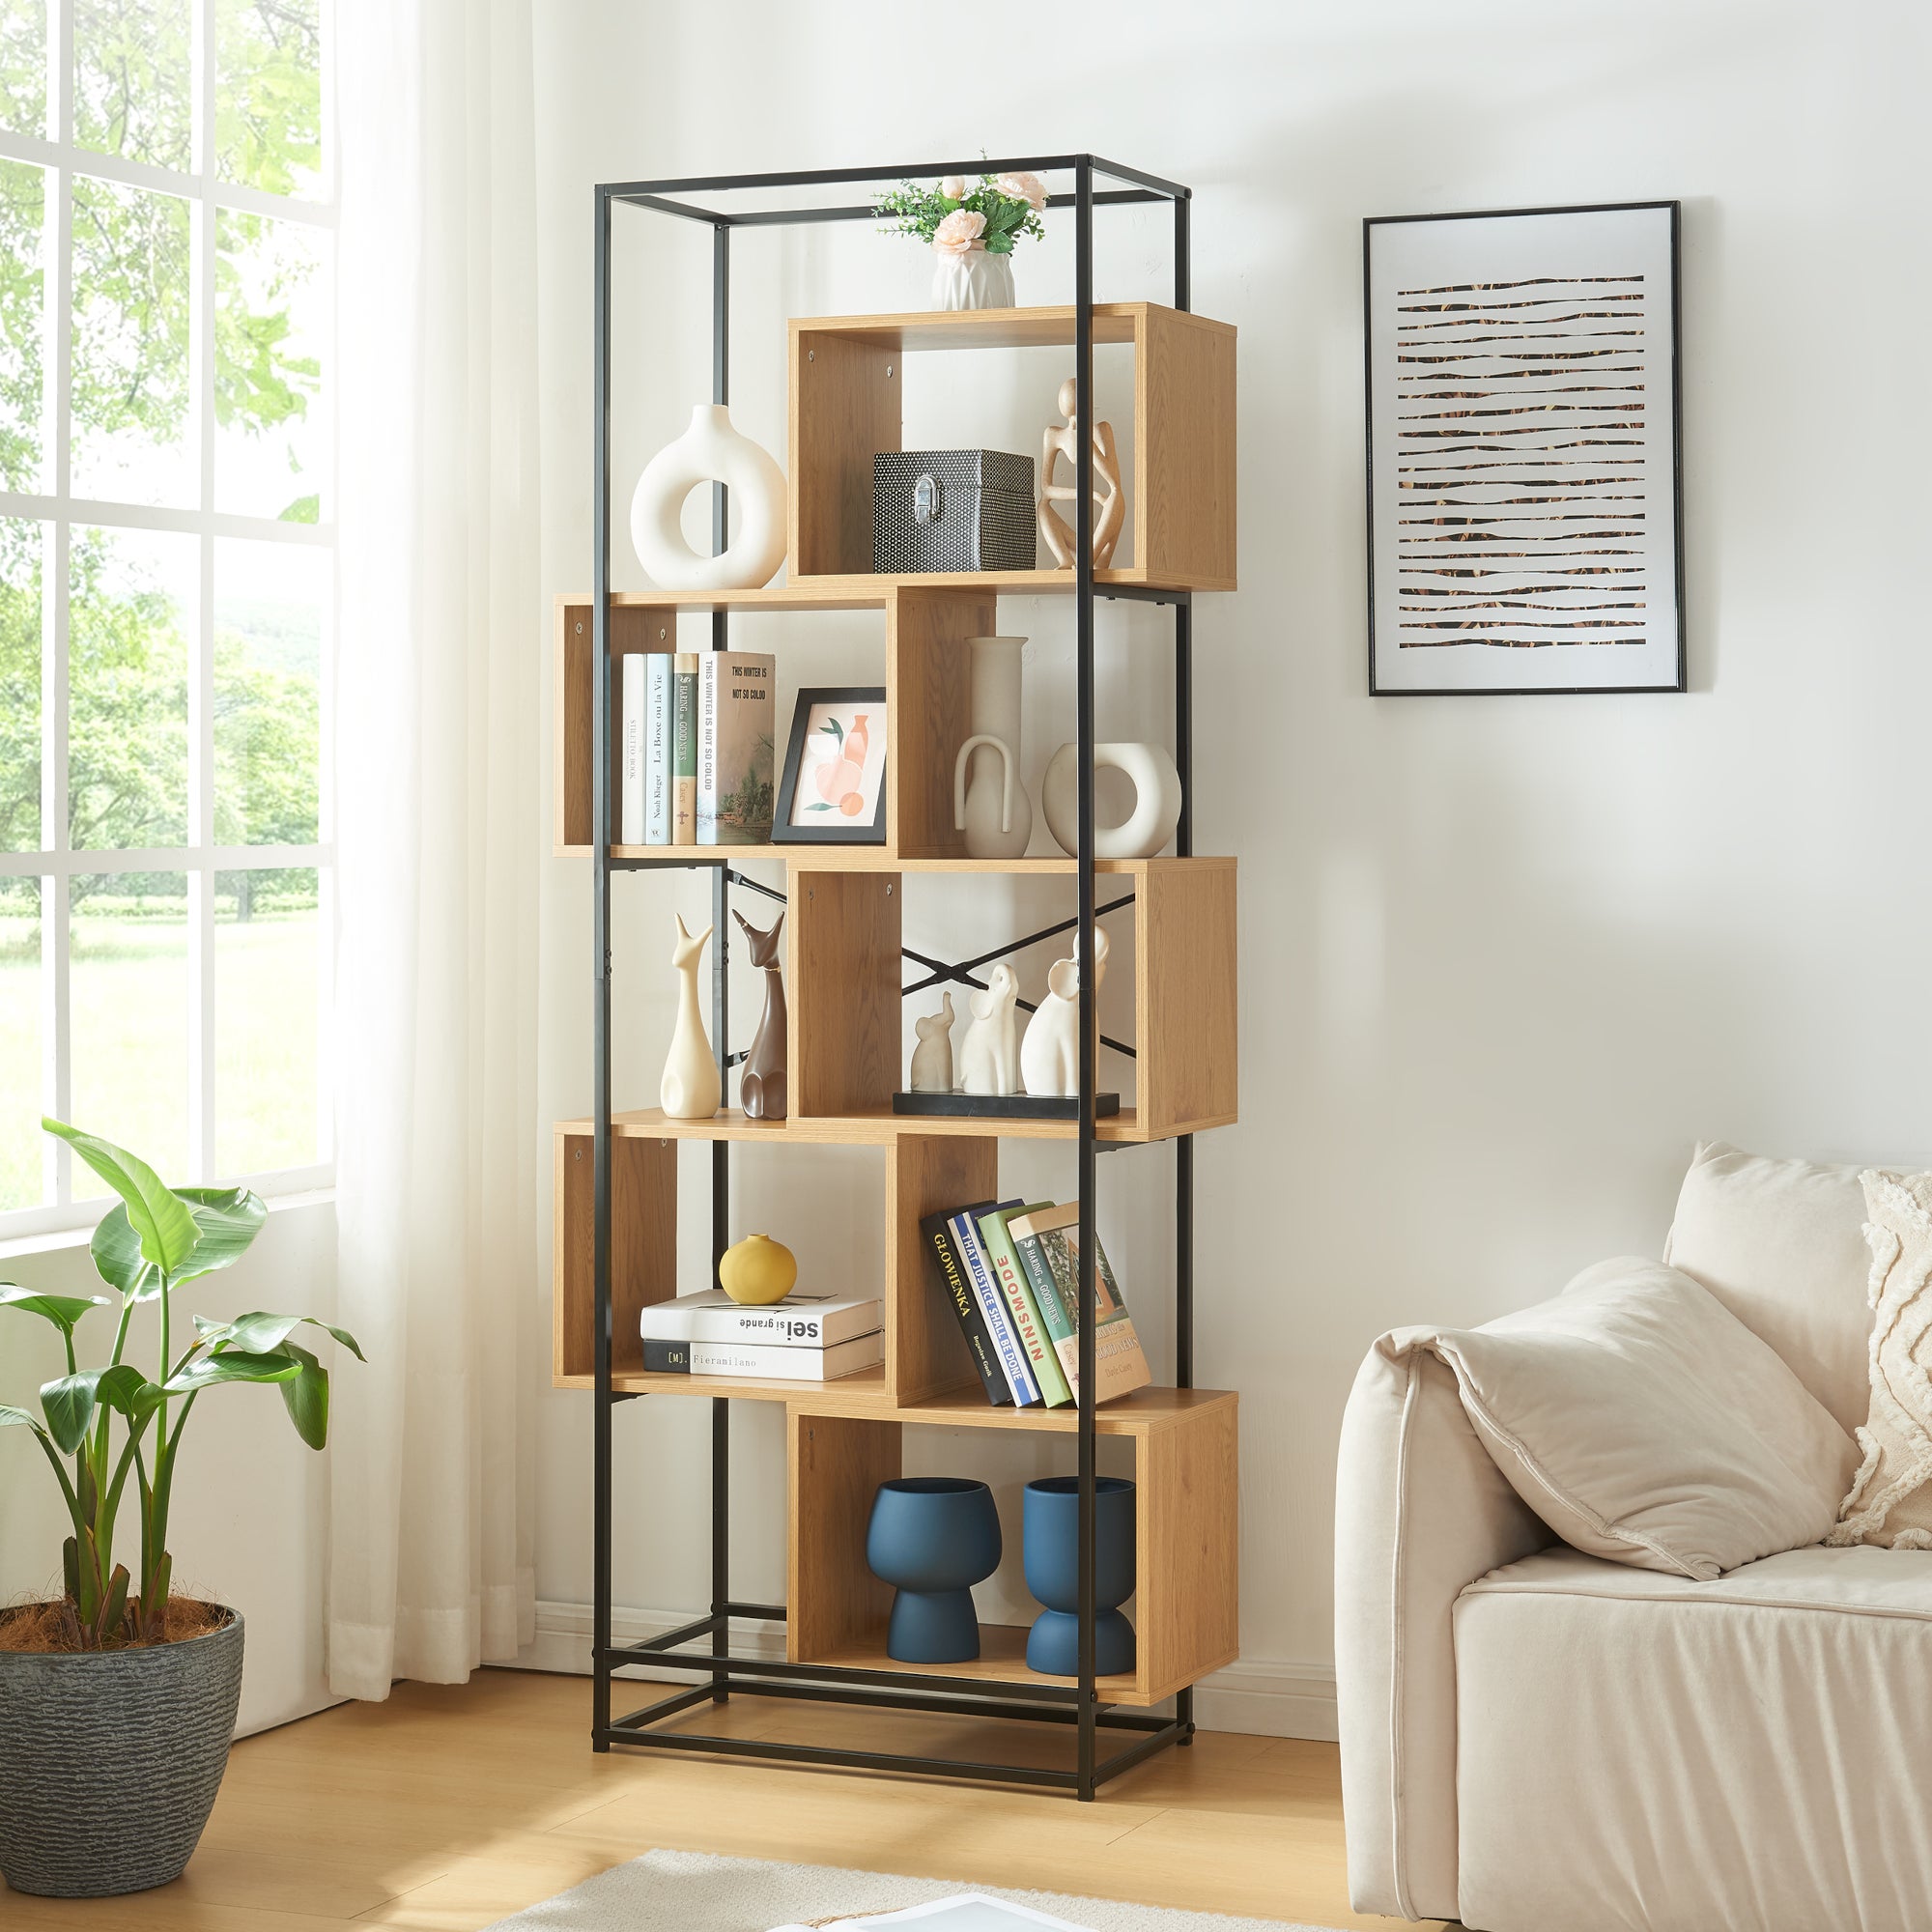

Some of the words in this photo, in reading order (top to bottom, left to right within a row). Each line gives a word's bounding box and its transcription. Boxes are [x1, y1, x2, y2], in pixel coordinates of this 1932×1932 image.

[732, 667, 743, 676] THIS
[744, 667, 760, 677] WINTER
[761, 668, 767, 677] IS
[654, 674, 663, 691] Vie
[654, 694, 662, 703] la
[732, 689, 742, 698] NOT
[743, 689, 749, 699] SO
[656, 706, 662, 719] ou
[679, 722, 688, 741] GOOD
[654, 750, 662, 763] La
[678, 741, 687, 761] NEWS
[705, 749, 712, 759] SO
[653, 775, 662, 798] Klieger
[962, 1233, 979, 1262] THAT
[972, 1264, 995, 1306] JUSTICE
[996, 1255, 1044, 1361] NINSMODE
[1039, 1284, 1053, 1305] GOOD
[1047, 1304, 1061, 1325] NEWS
[739, 1318, 774, 1329] grande
[776, 1321, 785, 1331] si
[786, 1321, 818, 1341] sei
[988, 1307, 1005, 1339] SHALL
[1000, 1338, 1012, 1352] BE
[694, 1354, 756, 1367] Fieramilano
[1005, 1352, 1023, 1381] DONE
